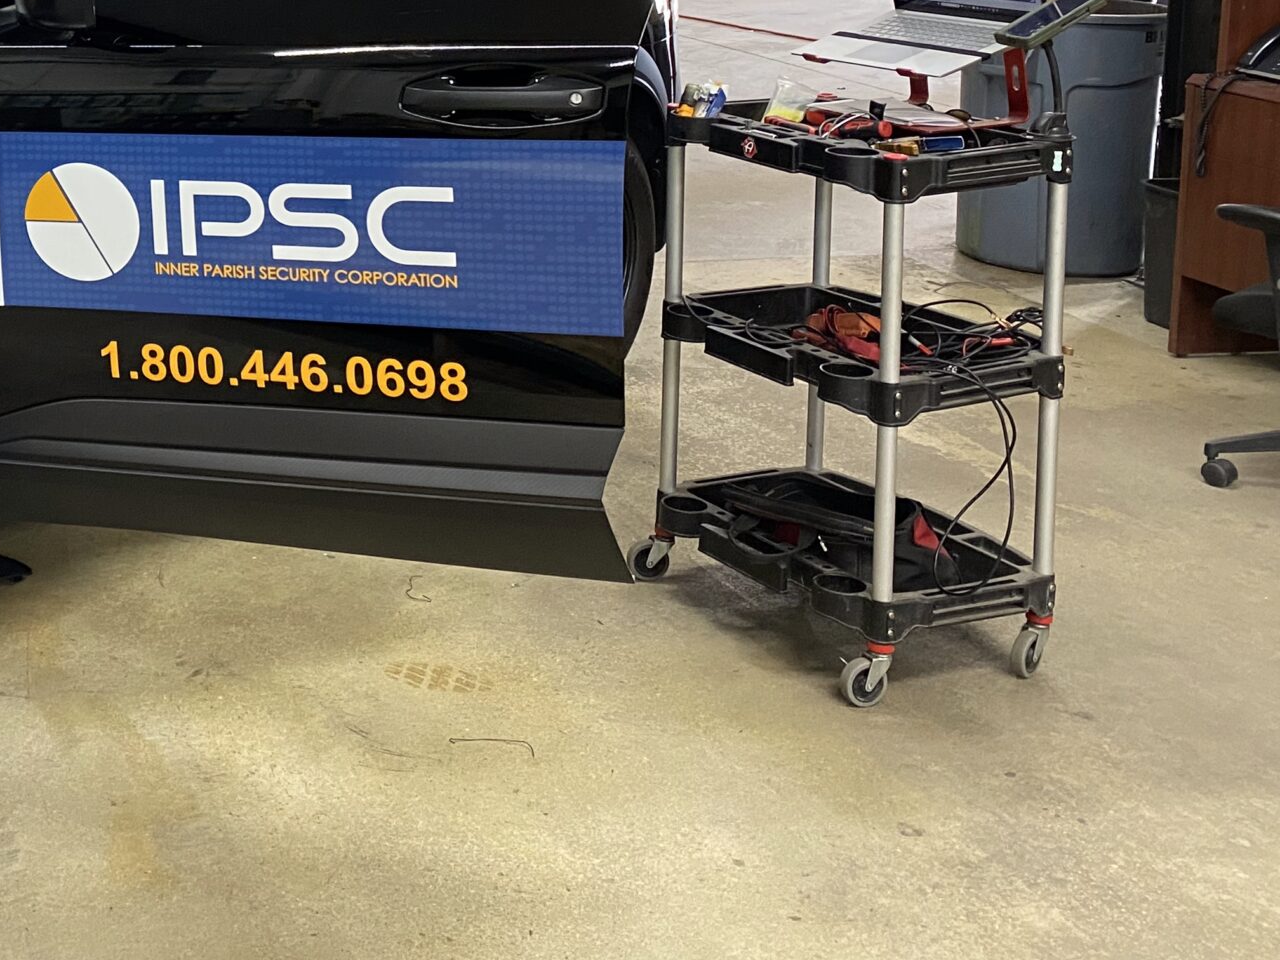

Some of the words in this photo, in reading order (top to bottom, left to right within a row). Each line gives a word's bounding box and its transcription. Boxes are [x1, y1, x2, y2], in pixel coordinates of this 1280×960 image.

[150, 178, 458, 269] IPSC
[154, 261, 199, 277] INNER
[203, 263, 257, 280] PARISH
[258, 266, 330, 283] SECURITY
[334, 269, 459, 289] CORPORATION
[99, 340, 469, 402] 1.800.446.0698
